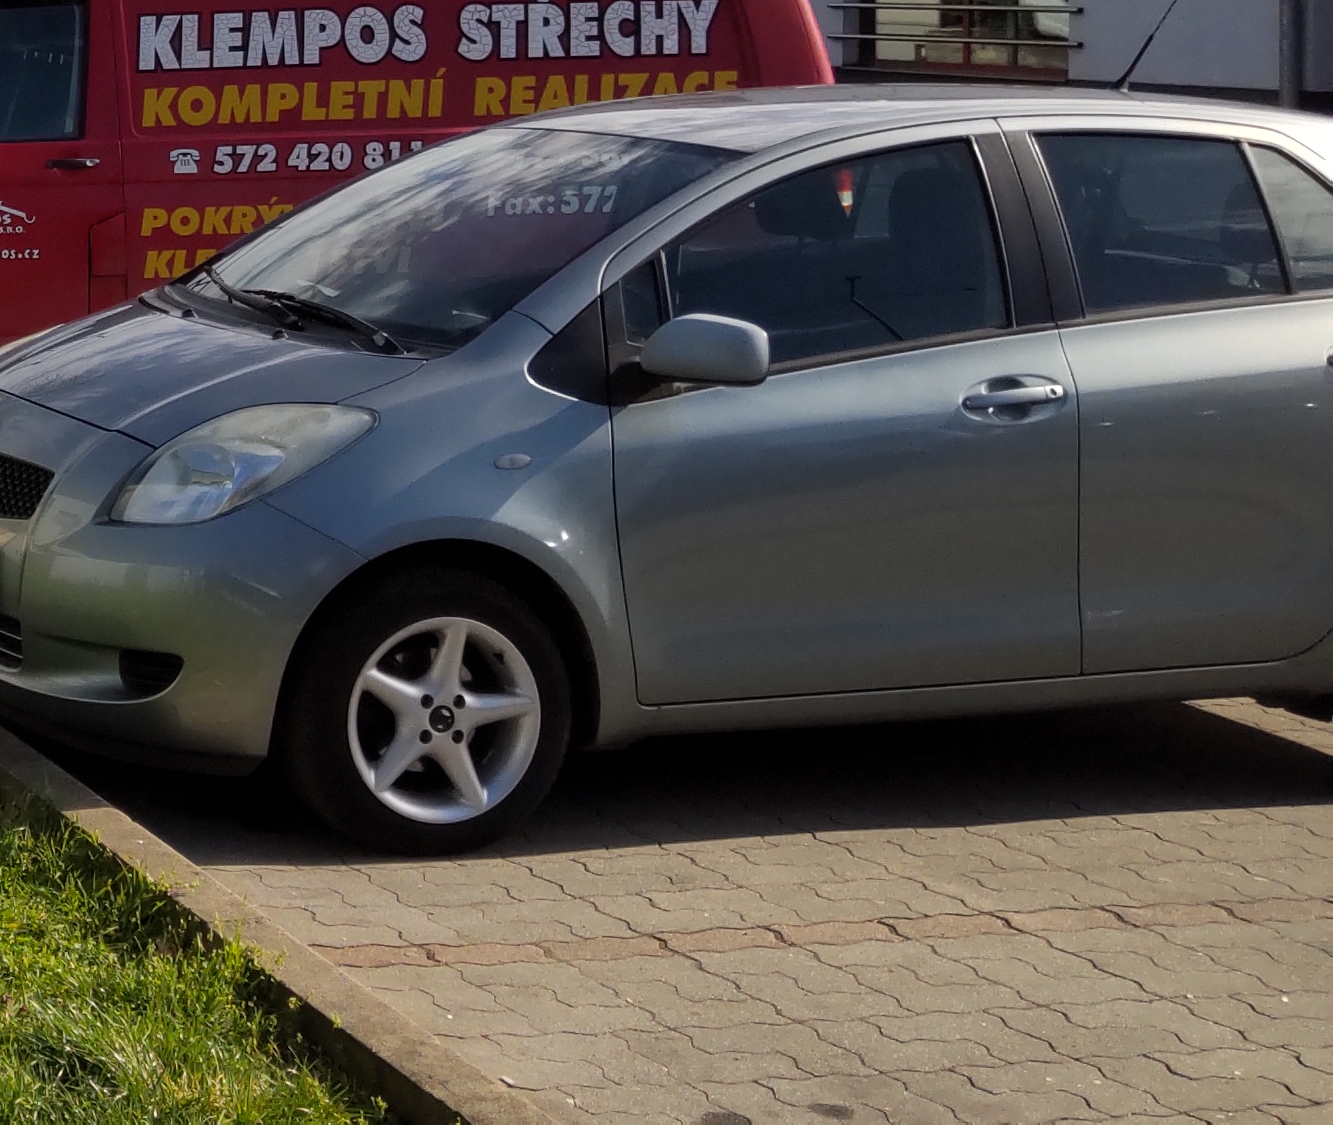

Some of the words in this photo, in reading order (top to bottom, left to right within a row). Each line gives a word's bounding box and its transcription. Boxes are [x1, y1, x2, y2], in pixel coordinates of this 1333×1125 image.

[138, 5, 427, 70] KLEMPOS
[142, 67, 446, 127] KOMPLETNÍ
[213, 144, 277, 173] 572
[287, 142, 352, 171] 420
[0, 225, 26, 234] S.R.O.
